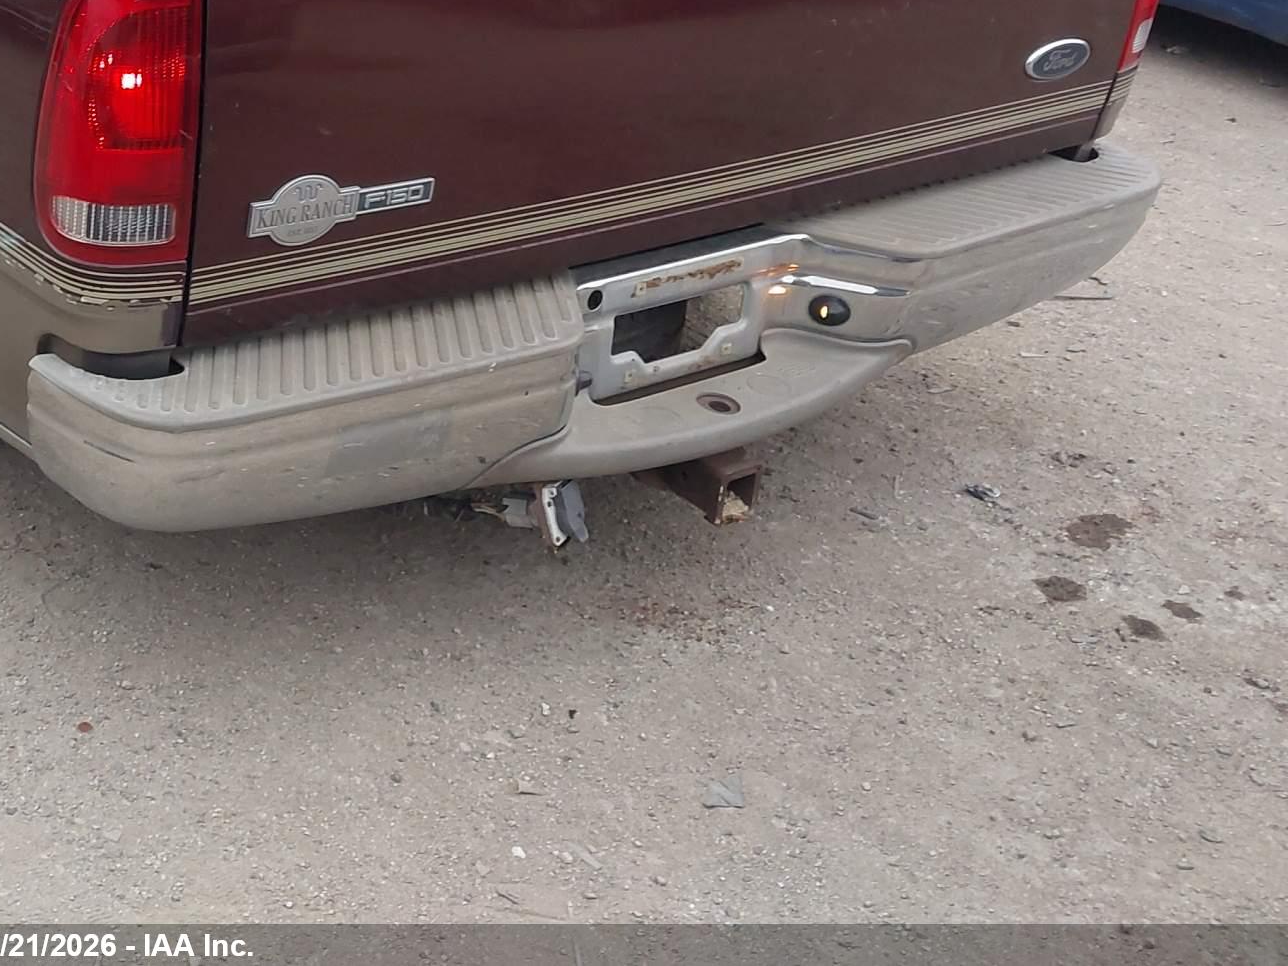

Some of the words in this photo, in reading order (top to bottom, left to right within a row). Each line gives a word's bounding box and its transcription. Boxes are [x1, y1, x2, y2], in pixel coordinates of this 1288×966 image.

[1043, 49, 1079, 72] Ford
[256, 207, 298, 228] KING
[300, 193, 355, 222] RANCH
